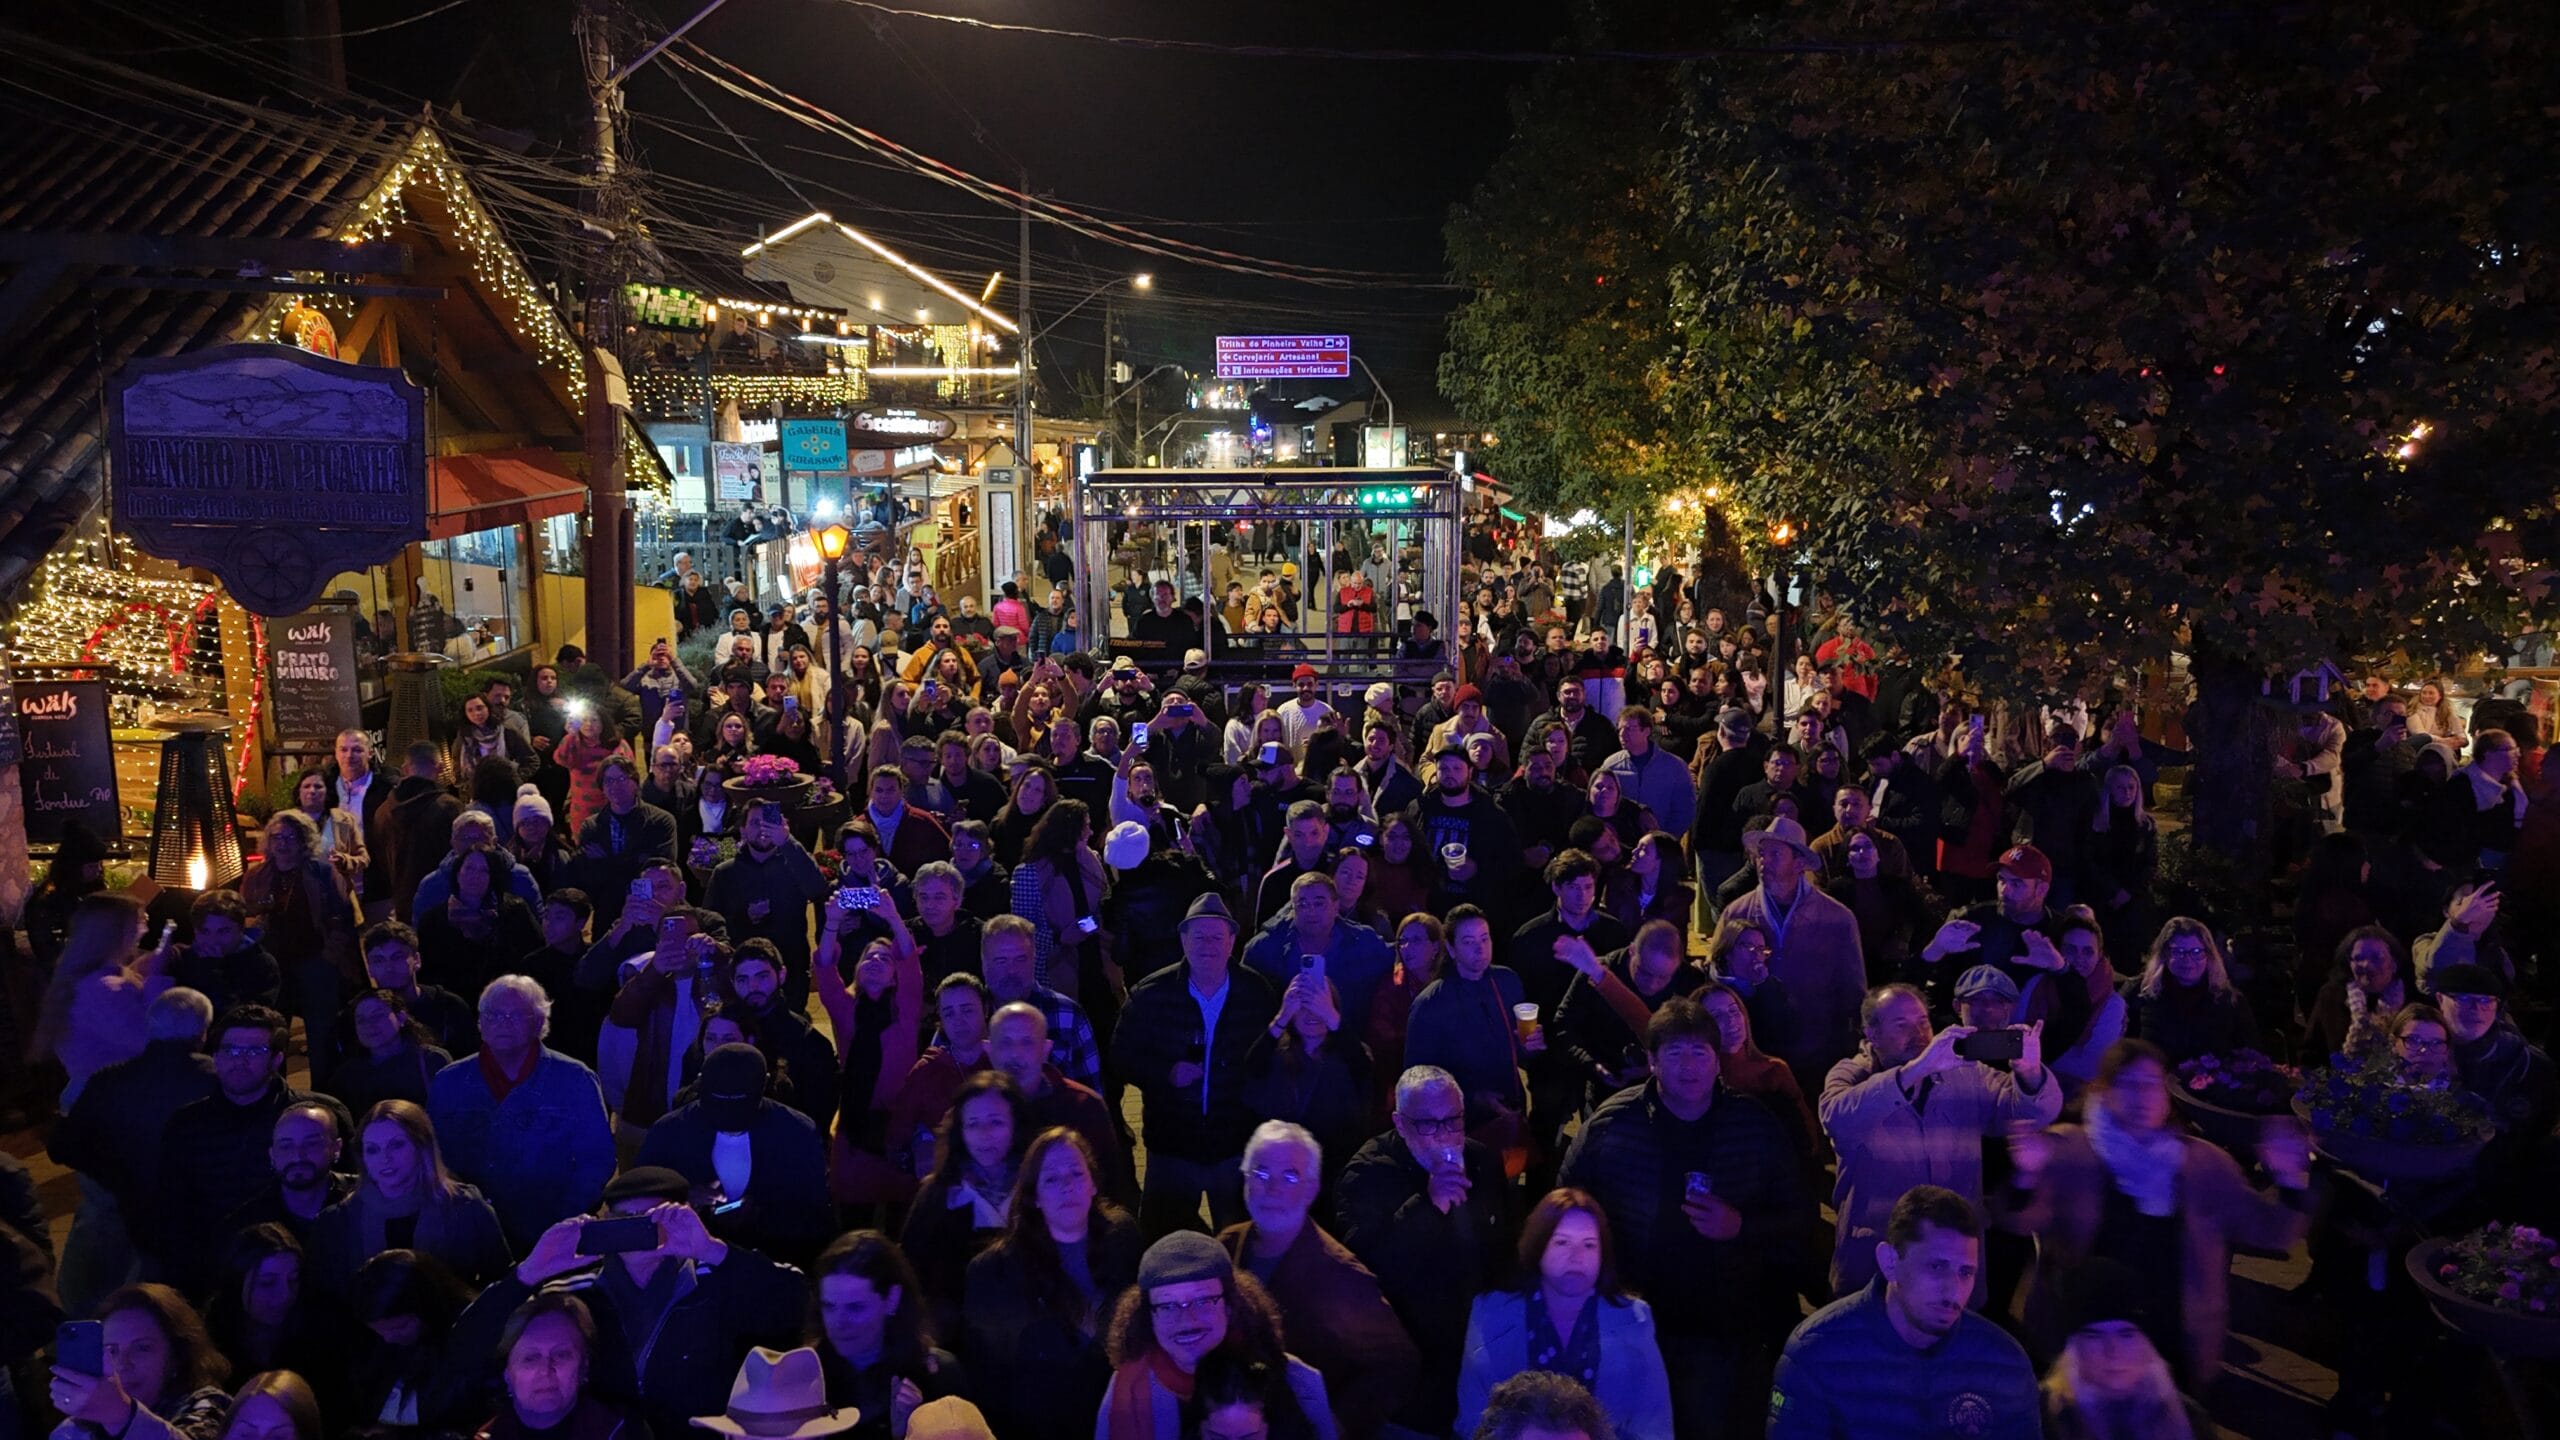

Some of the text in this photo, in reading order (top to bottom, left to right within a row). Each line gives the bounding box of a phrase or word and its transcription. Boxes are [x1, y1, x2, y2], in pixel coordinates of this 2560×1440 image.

[1221, 339, 1323, 348] Trilha do Pinheiro Velho
[1233, 352, 1319, 363] Cervejaria Artesanal
[788, 425, 842, 438] GALERIA
[244, 440, 285, 491] DA
[291, 441, 409, 496] PICANHA
[788, 453, 843, 467] GIRASSOL
[287, 622, 332, 644] wäls
[277, 650, 330, 668] PRATO
[276, 666, 339, 681] MINEIRO
[21, 690, 78, 720] wäls
[25, 730, 81, 760] Festival
[44, 765, 60, 781] de
[34, 779, 91, 811] Fondue
